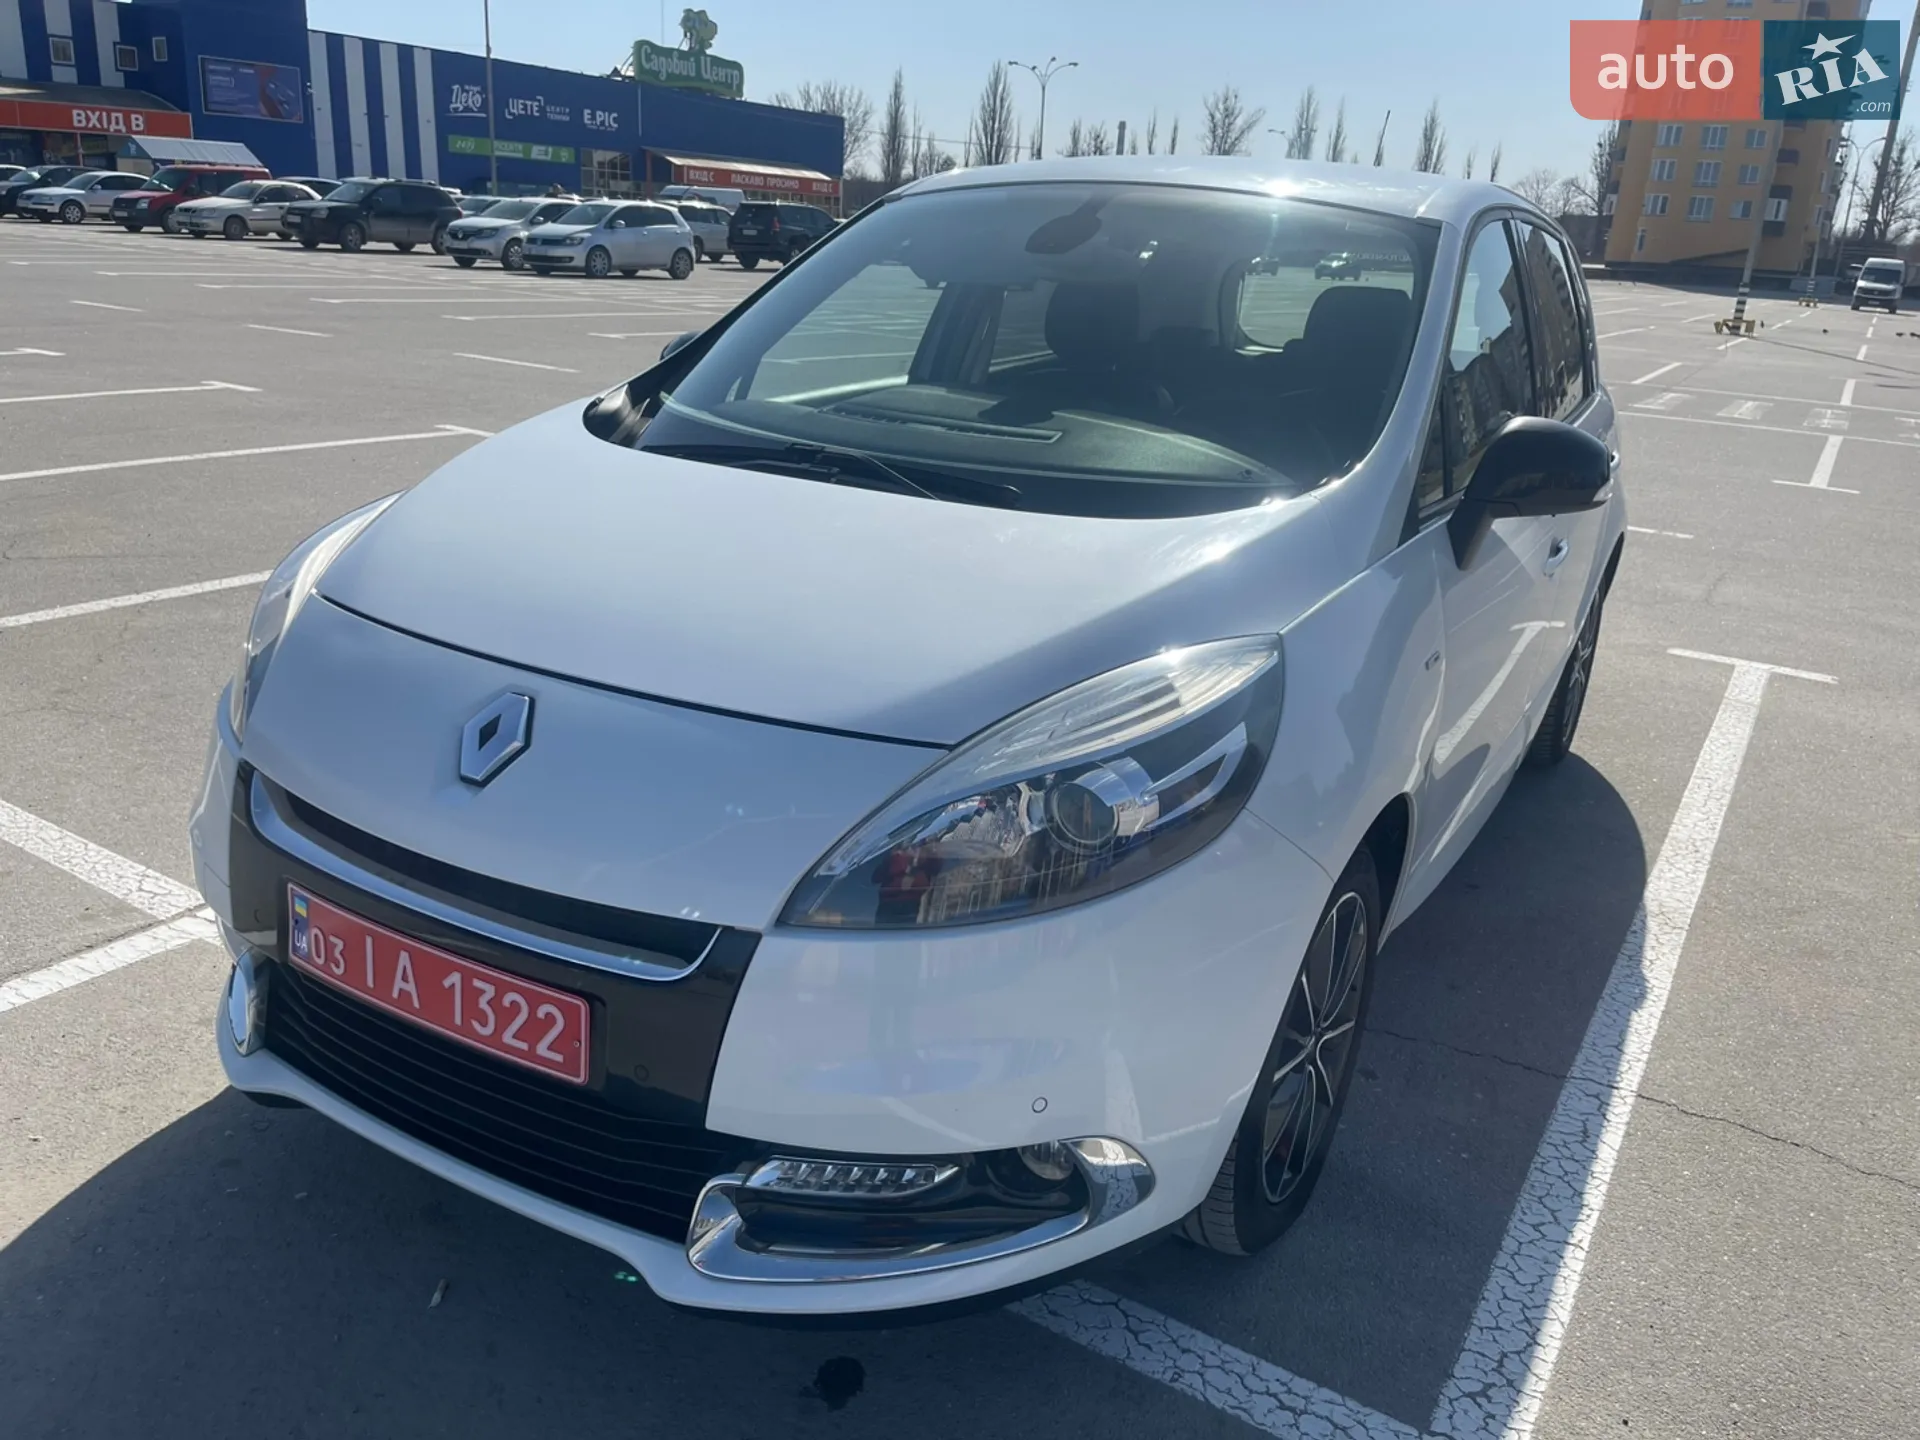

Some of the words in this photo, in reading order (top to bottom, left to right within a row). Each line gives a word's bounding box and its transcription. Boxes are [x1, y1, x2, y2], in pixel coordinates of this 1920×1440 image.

[640, 45, 697, 81] Садовий
[700, 56, 740, 91] Центр
[72, 109, 127, 133] ВХІД
[583, 108, 619, 128] E.PIC
[731, 173, 764, 187] ЛАСКАВО
[766, 177, 800, 189] ПРОСИМО
[293, 929, 308, 952] UA
[310, 926, 346, 976] 03
[441, 970, 566, 1064] 1322
